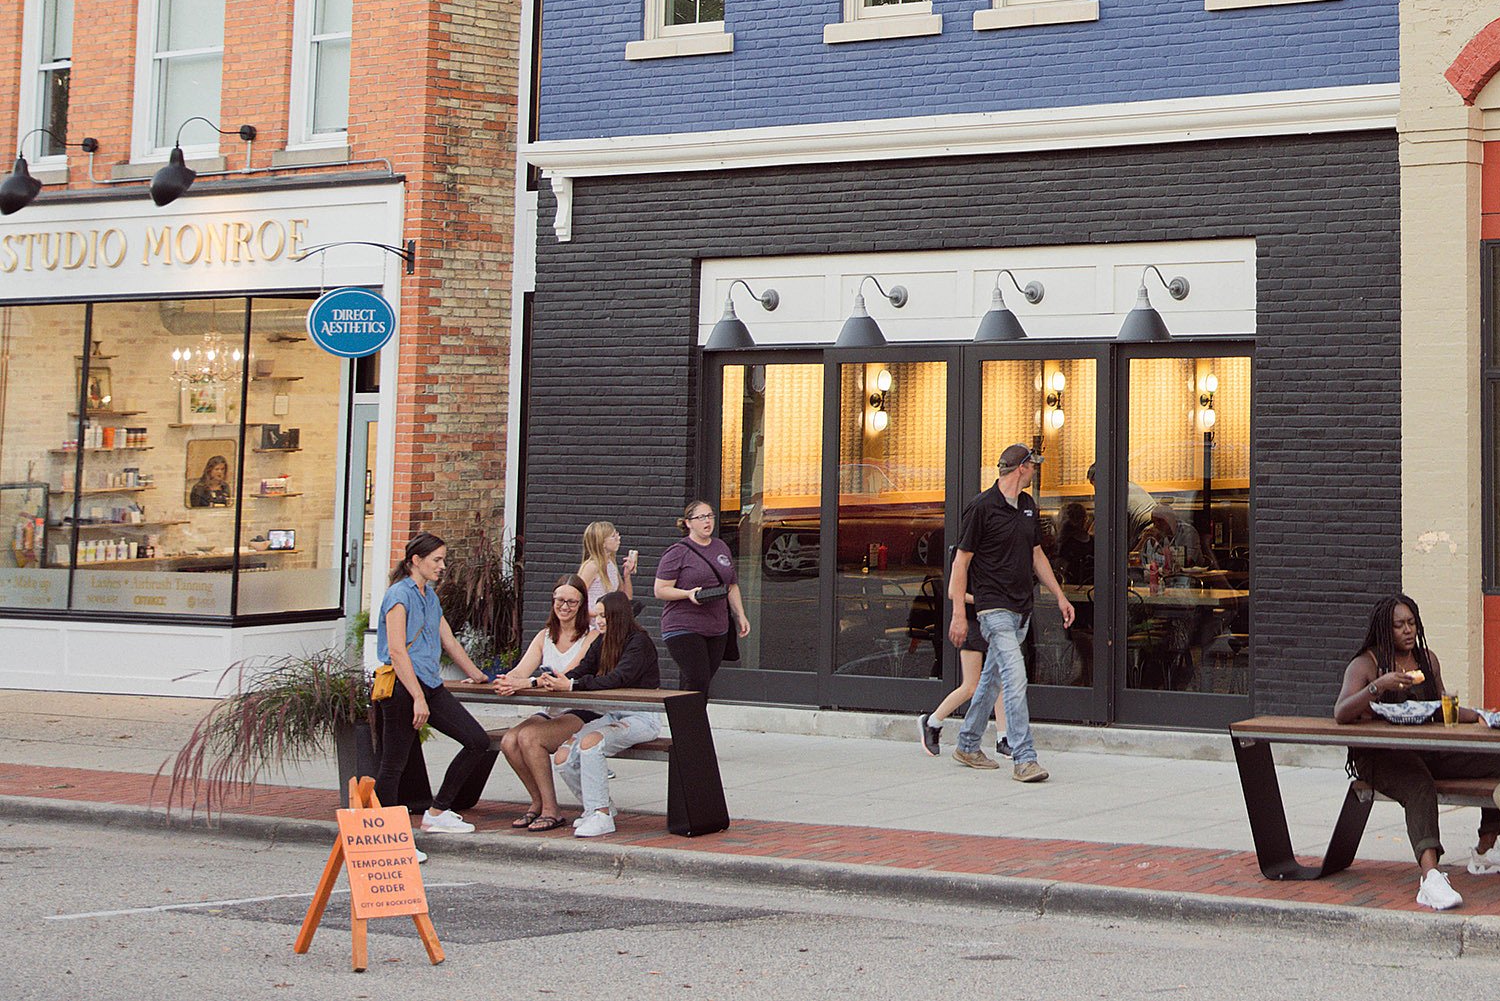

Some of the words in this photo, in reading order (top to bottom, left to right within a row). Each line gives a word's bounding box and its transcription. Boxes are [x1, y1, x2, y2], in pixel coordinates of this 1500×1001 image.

[0, 228, 127, 273] STUDIO
[141, 218, 310, 266] MONROE
[331, 309, 376, 321] DIRECT
[320, 320, 386, 336] AESTHETICS
[90, 575, 121, 589] Lashes
[175, 578, 214, 595] Tanning
[362, 817, 385, 829] NO
[347, 832, 409, 846] PARKING
[351, 856, 414, 869] TEMPORARY
[367, 870, 403, 881] POLICE
[370, 883, 406, 894] ORDER
[375, 900, 384, 908] OF
[386, 897, 422, 907] ROCKFORD
